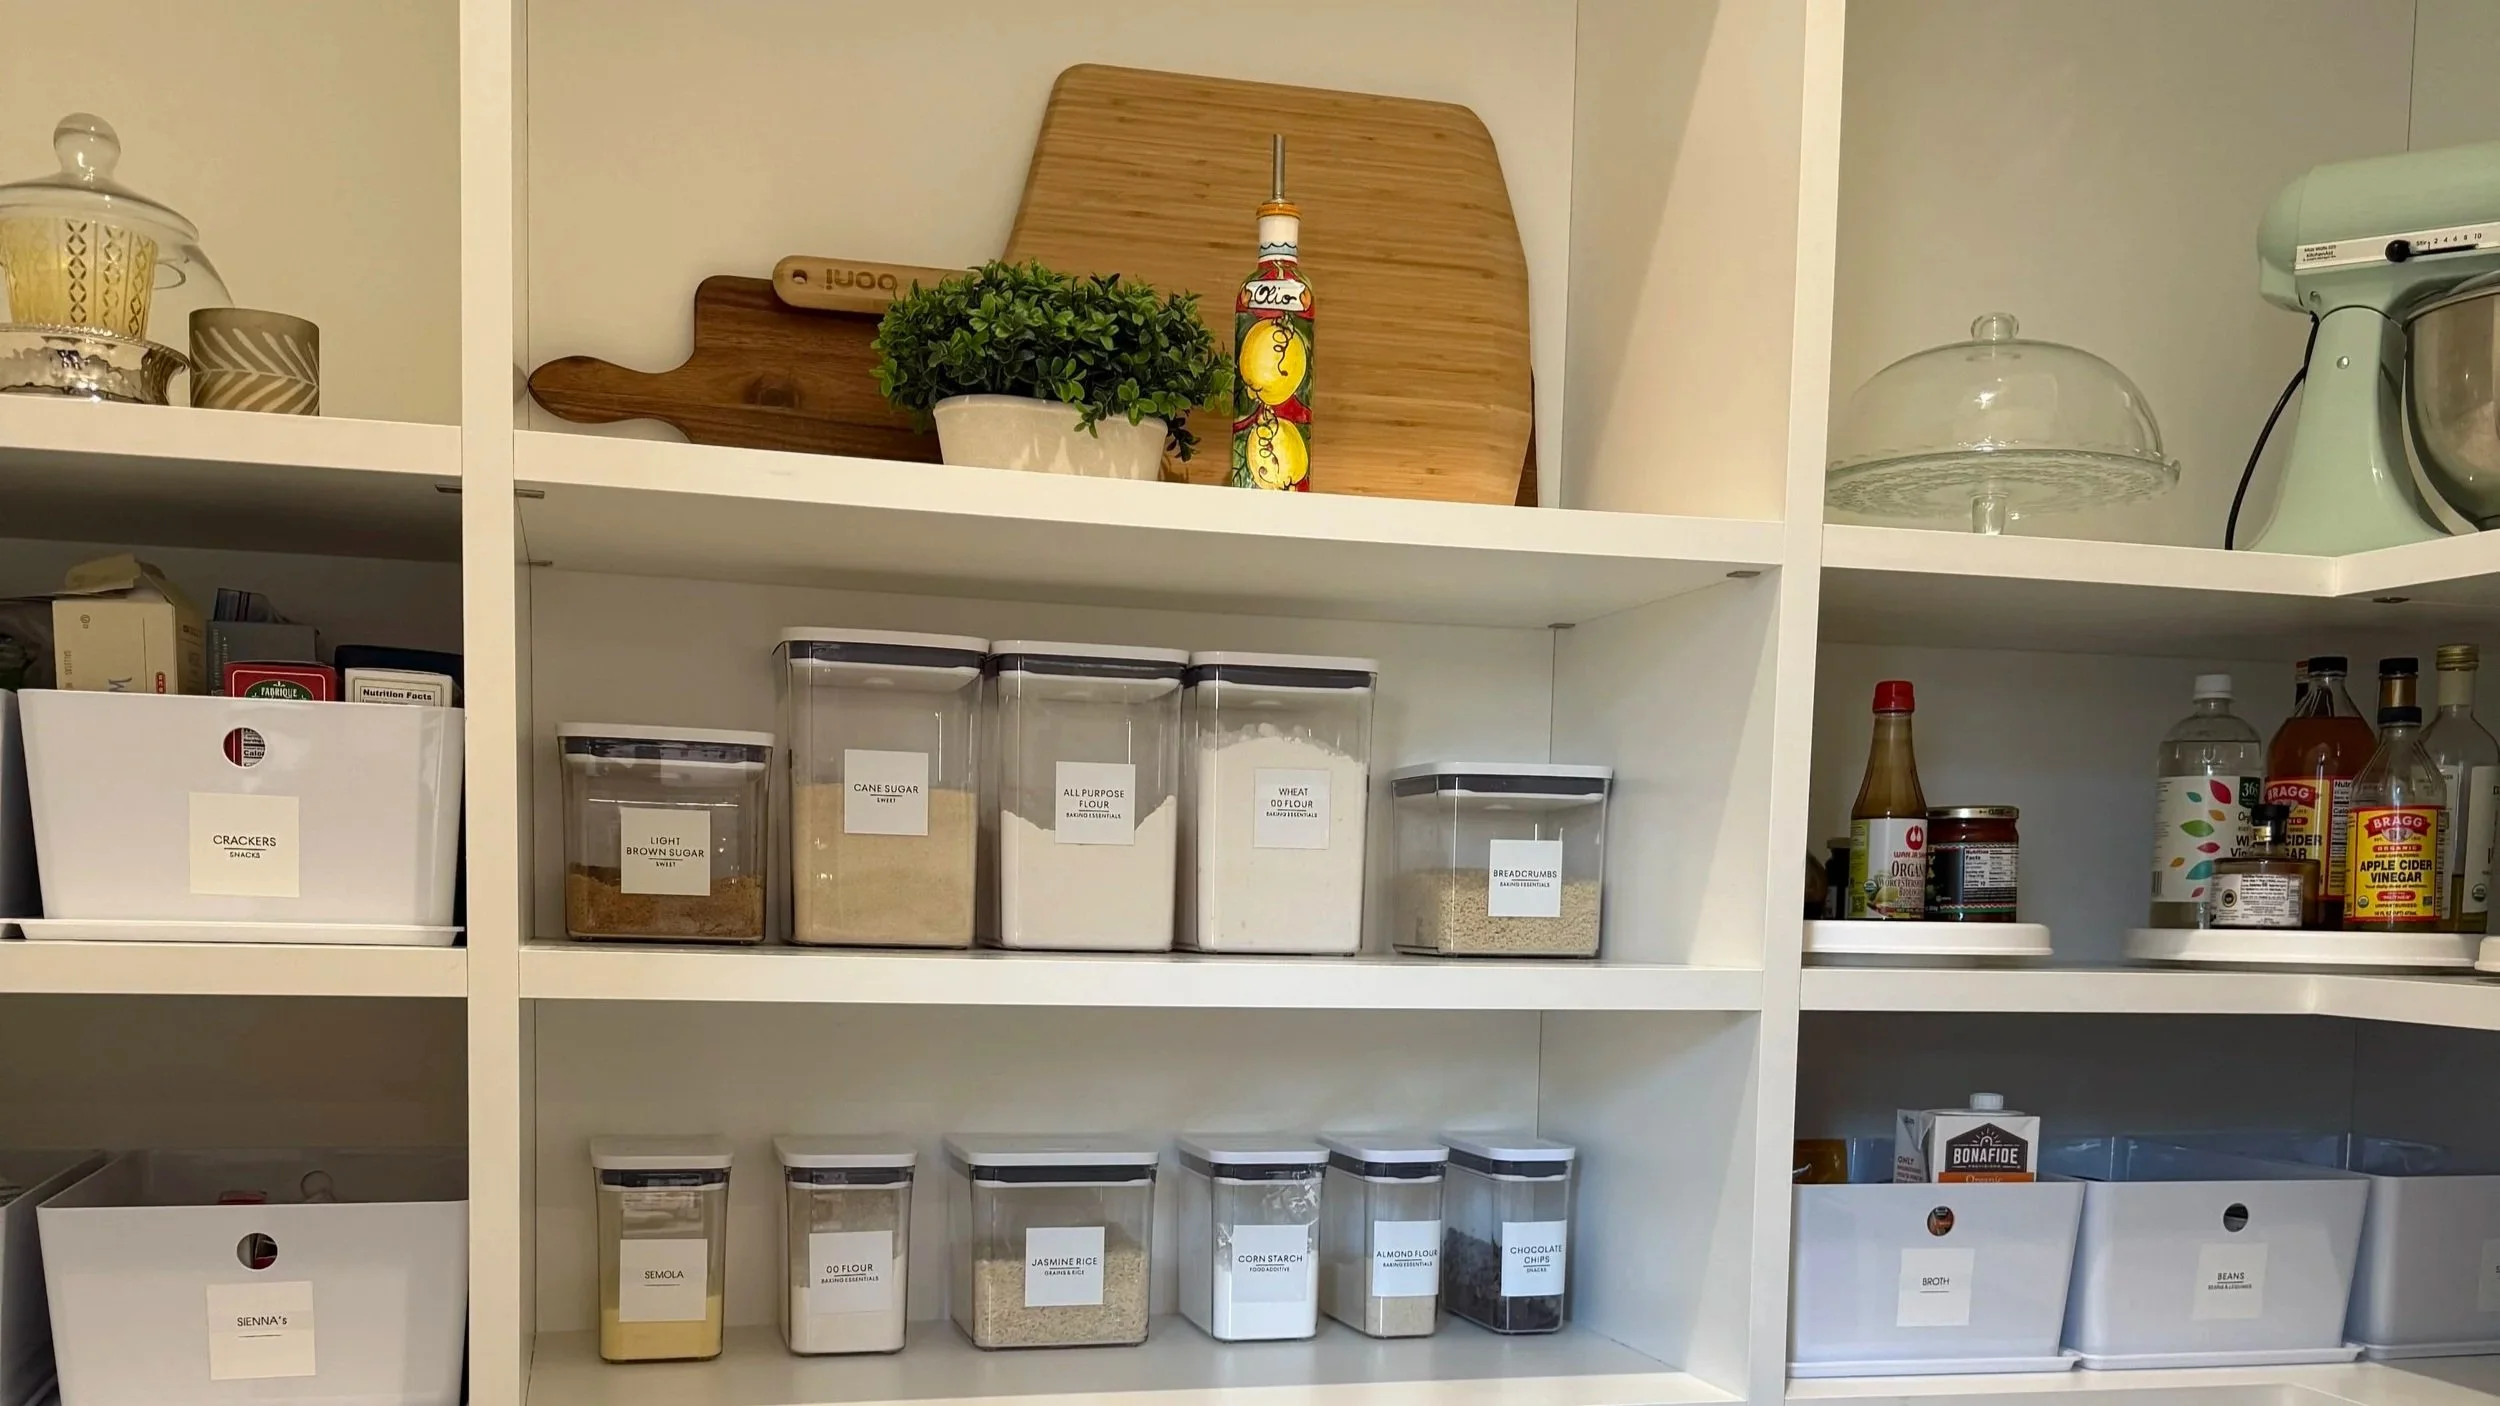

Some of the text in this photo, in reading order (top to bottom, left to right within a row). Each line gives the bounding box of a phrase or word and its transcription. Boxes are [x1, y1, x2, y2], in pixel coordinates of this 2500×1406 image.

[826, 268, 898, 290] ooni
[1254, 283, 1297, 305] Olio
[261, 687, 298, 698] FABRIQUE
[363, 689, 432, 700] Nutrition Facts
[854, 784, 919, 794] CANE SUGAR
[1064, 789, 1124, 798] ALL PURPOSE
[1279, 787, 1308, 796] WHEAT
[1079, 800, 1109, 808] FLOUR
[1284, 800, 1313, 808] FLOUR
[2373, 815, 2422, 829] BRAGG
[213, 834, 276, 846] CRACKERS
[650, 837, 680, 846] LIGHT
[626, 847, 704, 857] BROWN SUGAR
[2360, 860, 2432, 872] APPLE CIDER
[1493, 869, 1557, 878] BREADCRUMBS
[2371, 872, 2422, 883] VINEGAR
[1953, 1147, 2019, 1164] BONAFIDE
[1376, 1249, 1438, 1258] ALMOND FLOUR
[1510, 1245, 1563, 1254] CHOCOLATE
[1032, 1257, 1098, 1267] JASMINE RICE
[1238, 1254, 1303, 1263] CORN STARCH
[1524, 1256, 1550, 1264] CHIPS
[841, 1264, 873, 1273] FLOUR
[644, 1270, 684, 1279] SEMOLA
[2218, 1272, 2244, 1280] BEANS
[1922, 1277, 1950, 1286] BROTH
[237, 1316, 287, 1327] SIENNA's
